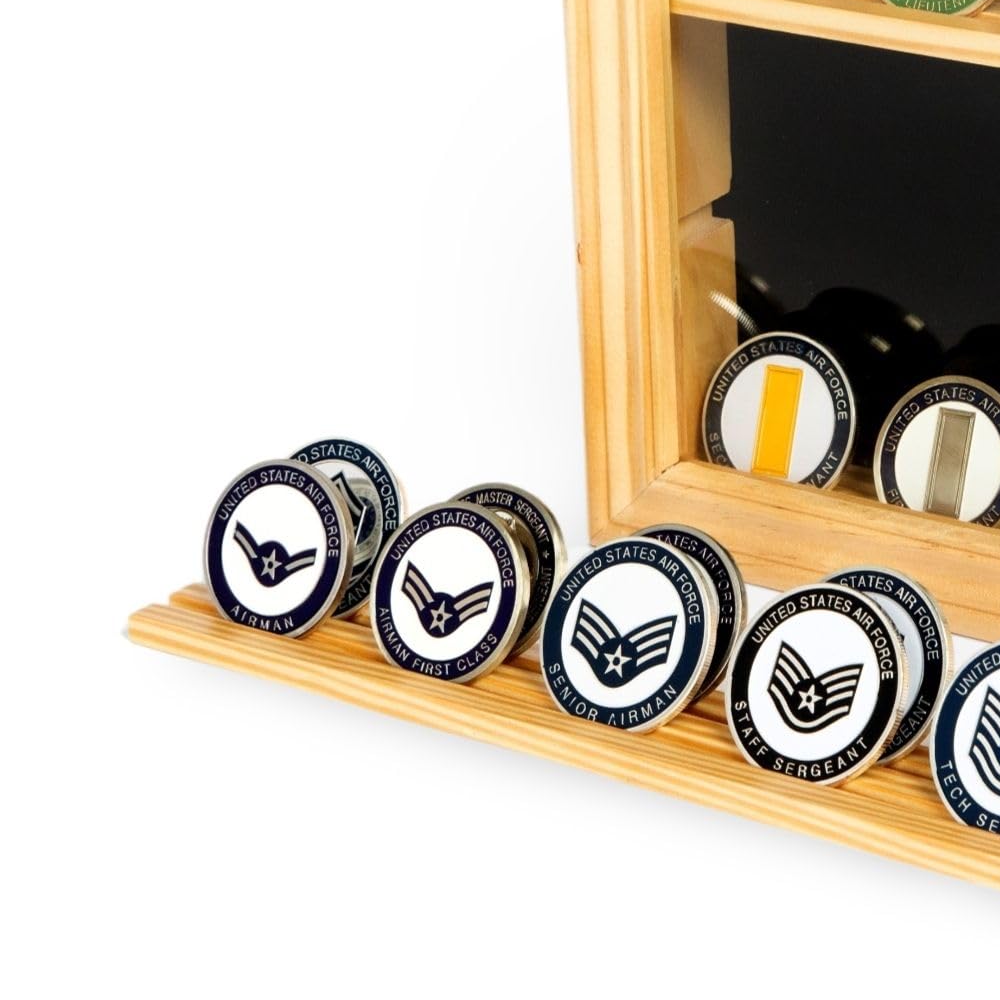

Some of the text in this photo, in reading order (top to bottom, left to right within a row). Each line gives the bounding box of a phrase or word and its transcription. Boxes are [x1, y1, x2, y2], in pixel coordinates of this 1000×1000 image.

[712, 341, 847, 421] UNITED STATES AIR FORCE
[885, 403, 920, 452] UNITED
[924, 387, 976, 405] STATES
[979, 398, 1000, 418] AIR
[218, 469, 339, 557] UNITED STATES AIR FORCE
[311, 444, 396, 531] STATES AIR FORCE
[476, 492, 550, 543] MASTER SERGEANT
[391, 512, 514, 588] UNITED STATES AIR FORCE
[561, 546, 700, 624] UNITED STATES AIR FORCE
[699, 546, 719, 569] AIR
[718, 569, 734, 624] FORCE
[230, 605, 294, 631] AIRMAN
[379, 608, 498, 676] AIRMAN FIRST CLASS
[752, 595, 894, 680] UNITED STATES AIR FORCE
[840, 576, 940, 661] STATES AIR FORCE
[549, 663, 676, 726] SENIOR AIRMAN
[735, 702, 868, 778] STAFF SERGEANT
[941, 761, 972, 813] TECH
